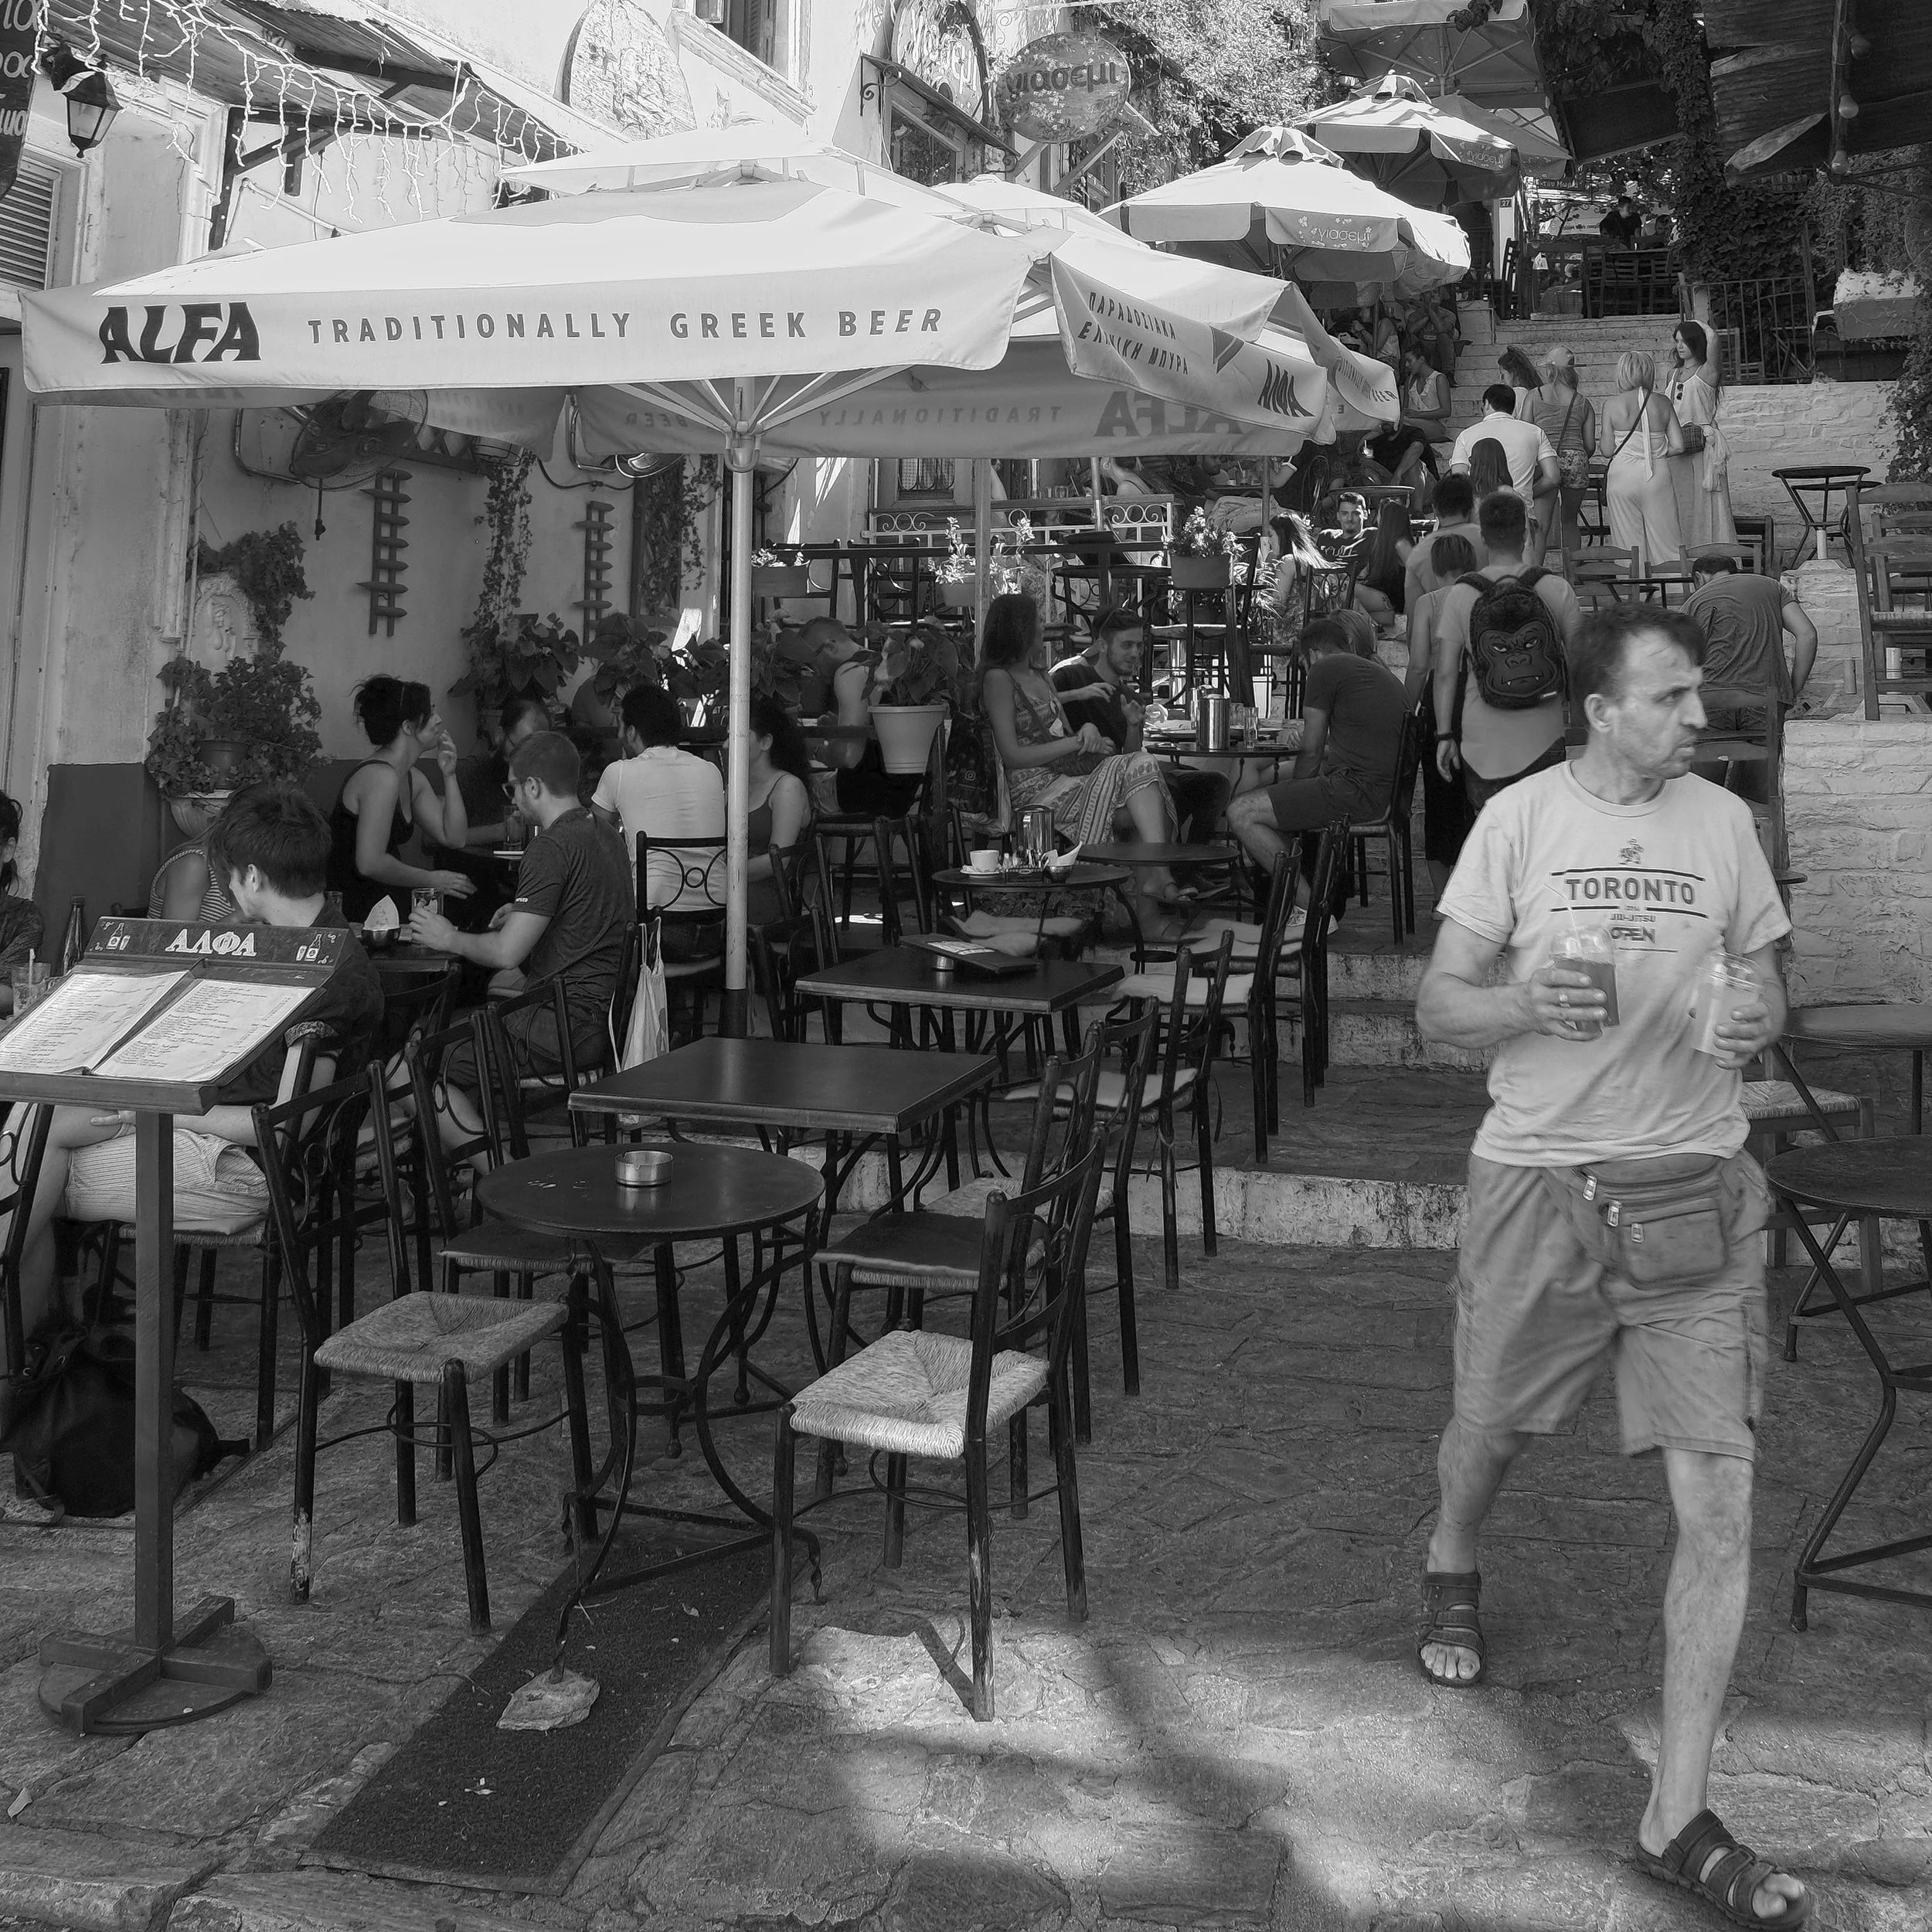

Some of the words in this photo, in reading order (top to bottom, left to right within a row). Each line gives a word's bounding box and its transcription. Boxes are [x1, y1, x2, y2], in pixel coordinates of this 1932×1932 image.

[100, 301, 262, 364] ALFA
[308, 312, 631, 345] TRADITIONALLY
[669, 311, 807, 338] GREEK
[838, 308, 942, 337] BEER
[1566, 877, 1695, 905] TORONTO
[165, 929, 257, 957] ΑΛΦΑ
[1611, 927, 1655, 943] OPEN
